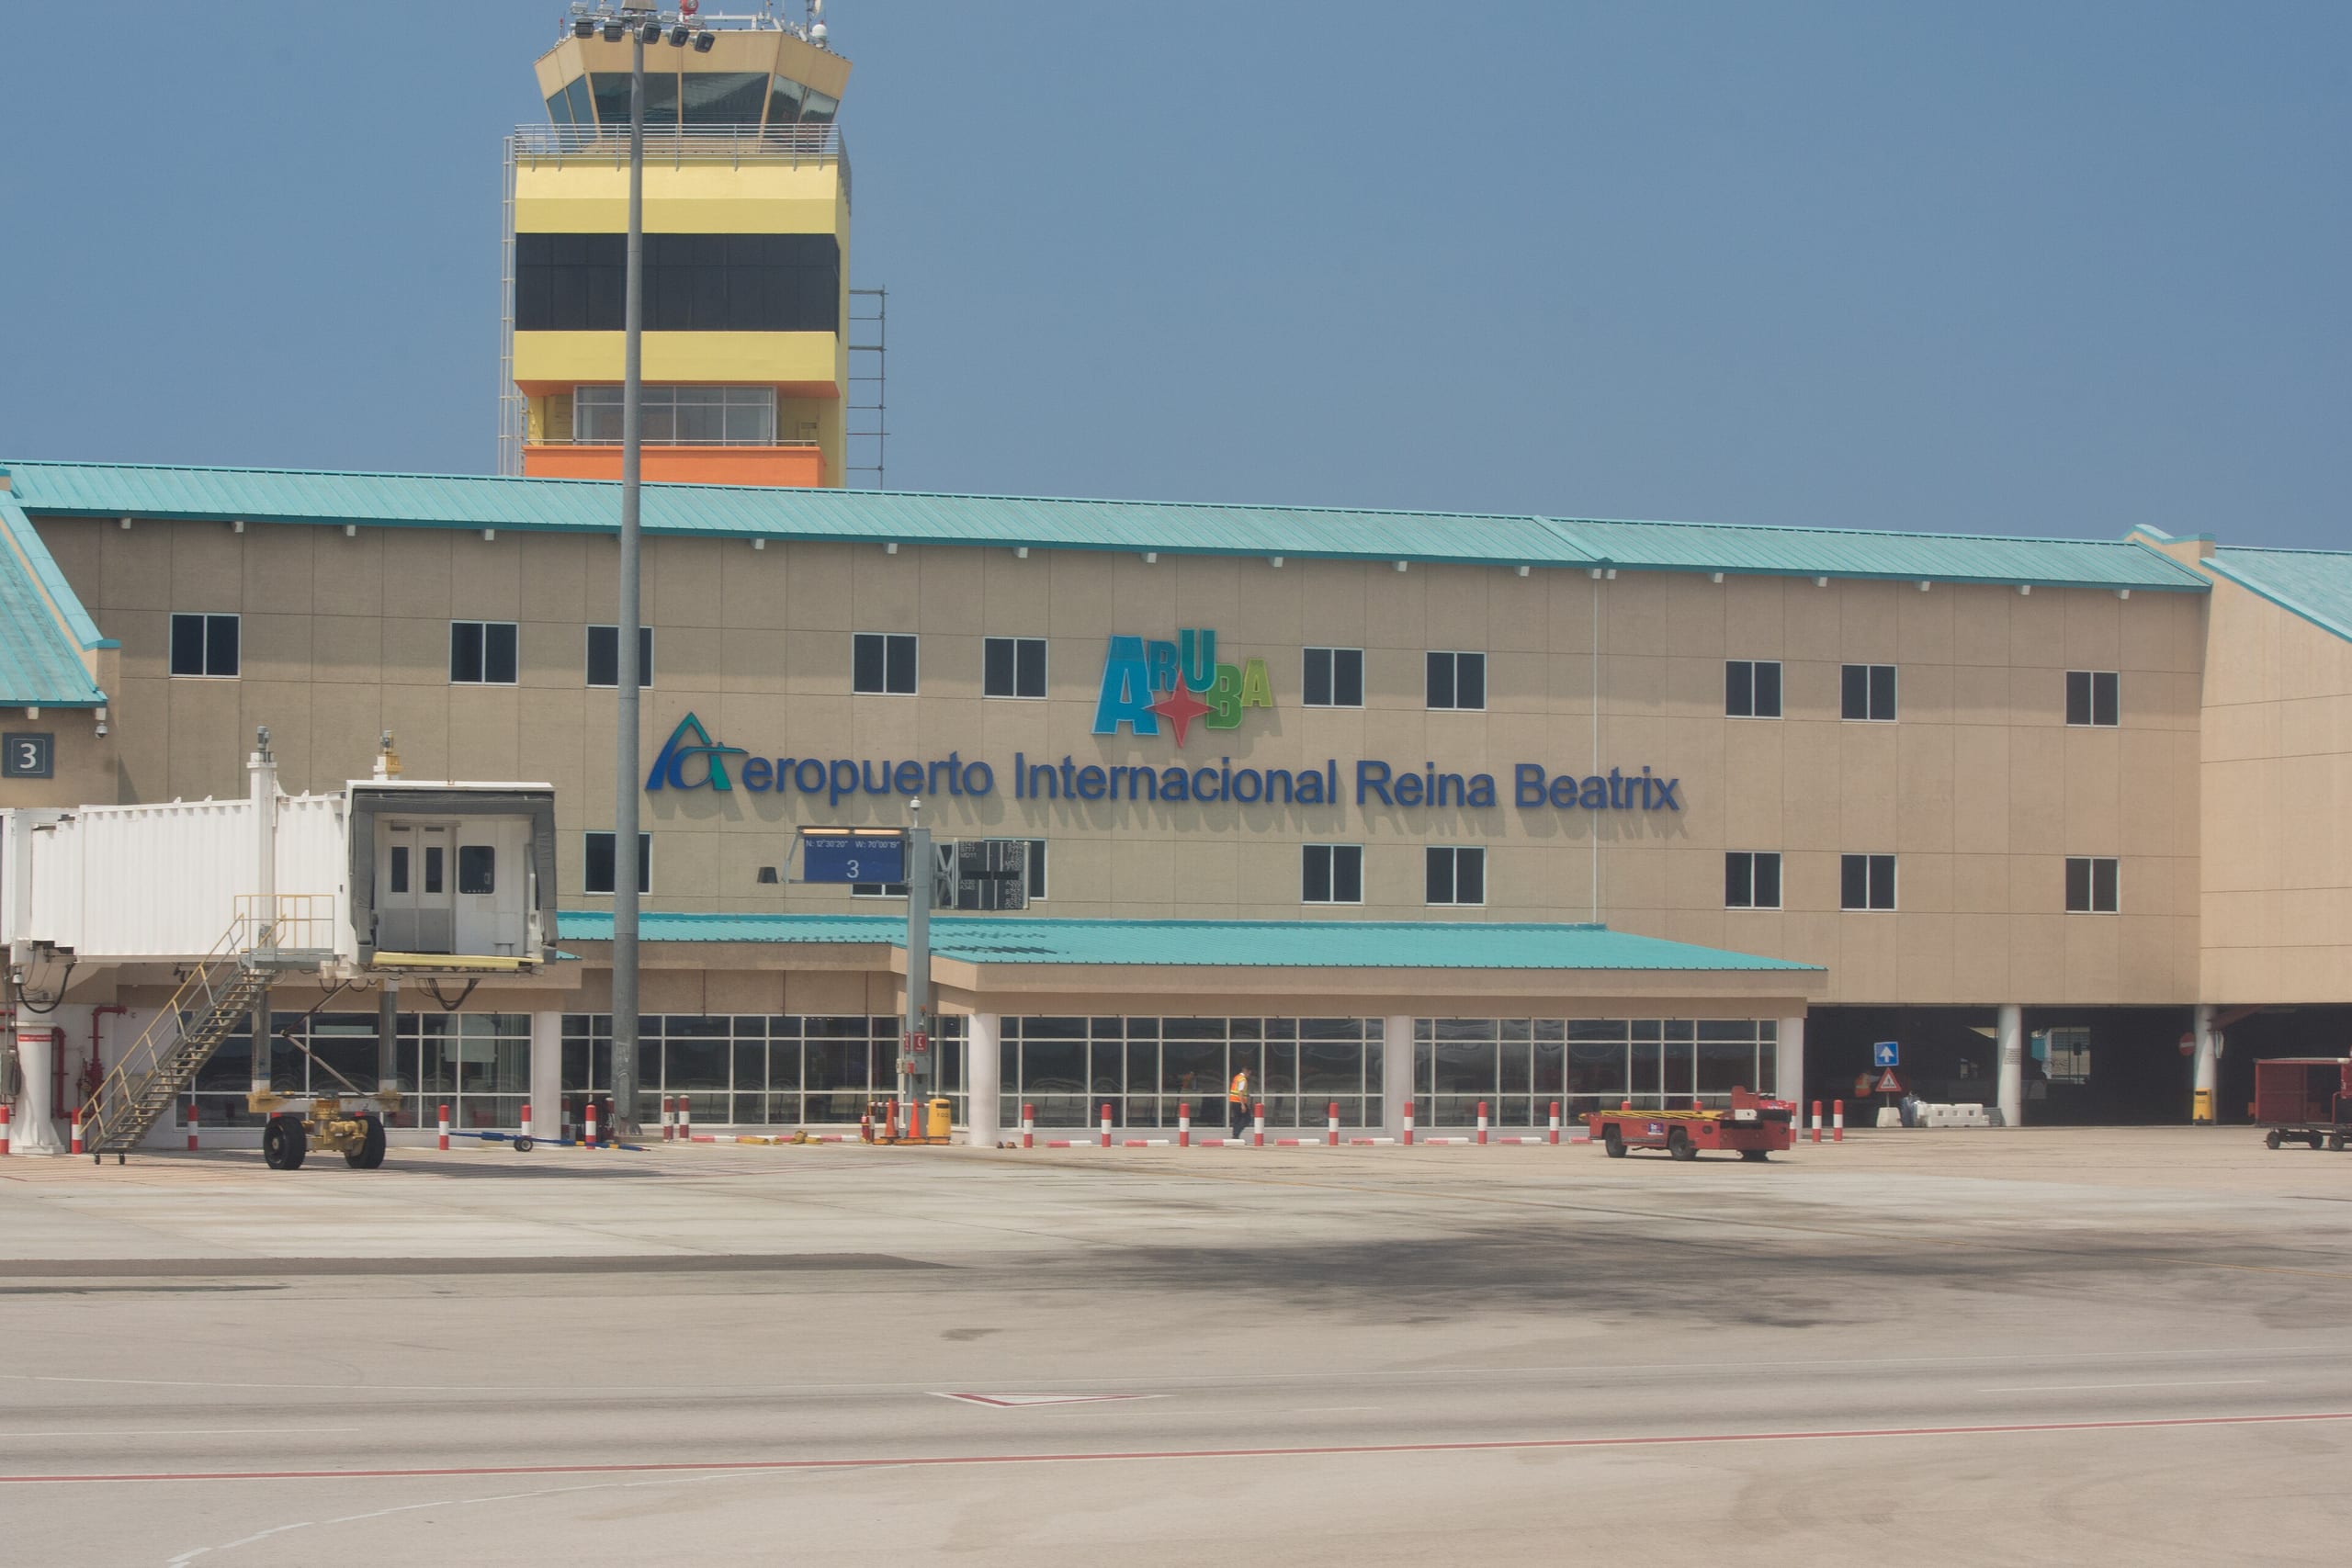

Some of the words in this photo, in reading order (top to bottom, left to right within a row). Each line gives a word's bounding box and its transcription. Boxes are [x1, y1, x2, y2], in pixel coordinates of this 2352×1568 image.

[1091, 628, 1272, 736] ARUBA
[19, 742, 38, 769] 3
[646, 712, 994, 807] Aeropuerto
[1015, 752, 1337, 805] Internacional
[1356, 760, 1496, 807] Reina
[1515, 763, 1680, 810] Beatrix
[846, 859, 860, 879] 3
